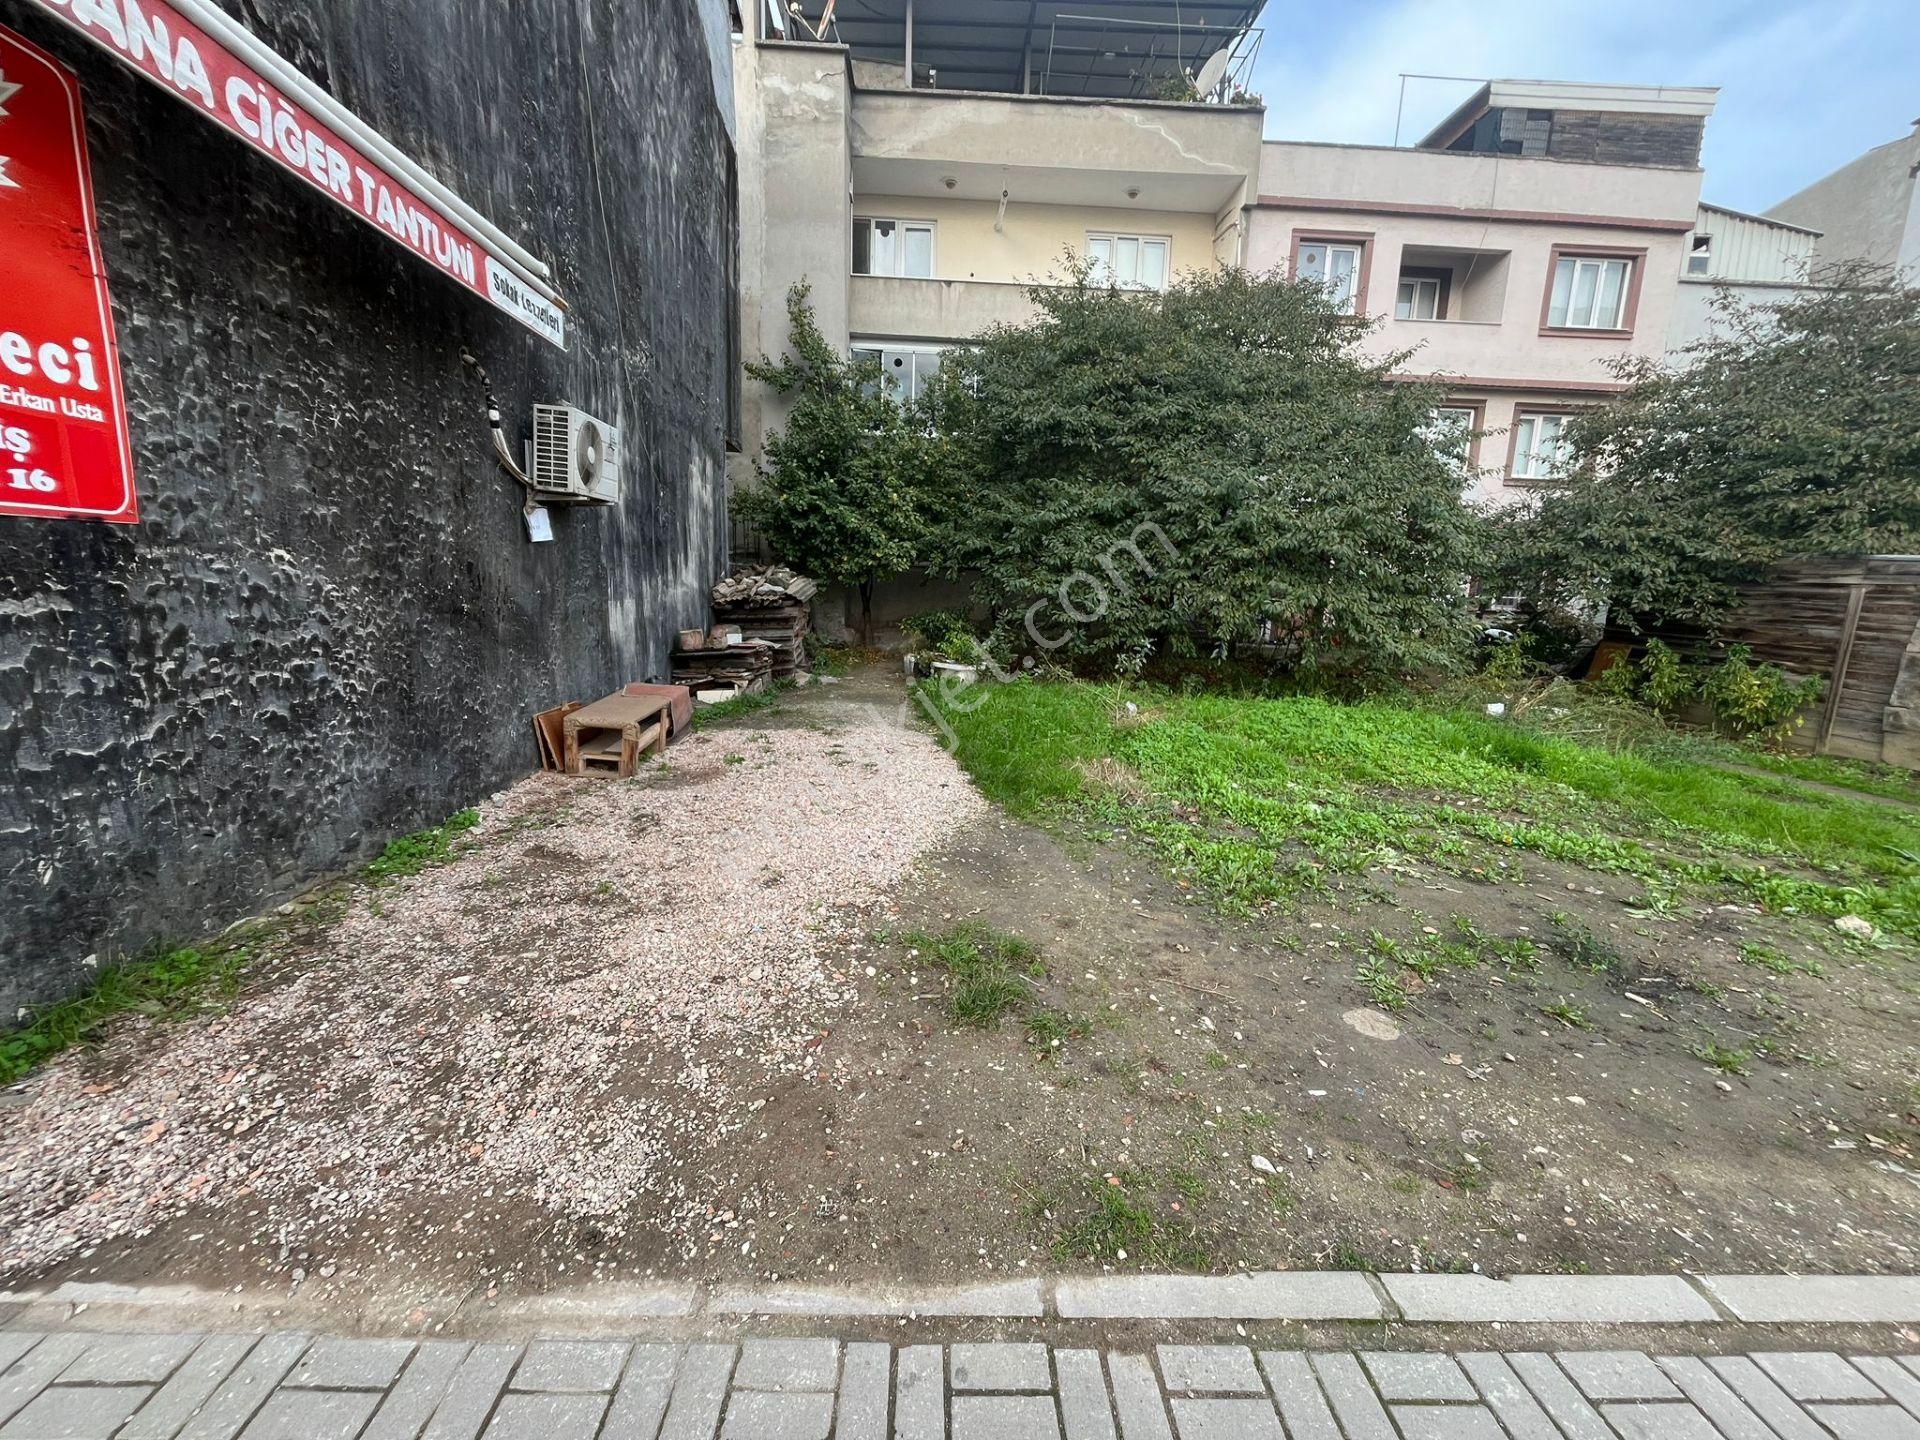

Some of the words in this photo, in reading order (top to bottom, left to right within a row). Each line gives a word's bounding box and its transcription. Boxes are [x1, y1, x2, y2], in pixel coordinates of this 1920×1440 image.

[50, 0, 215, 109] ANA
[225, 75, 352, 202] CİĞER
[355, 165, 475, 285] TANTUNİ
[60, 396, 104, 422] Usta
[6, 468, 56, 492] 16
